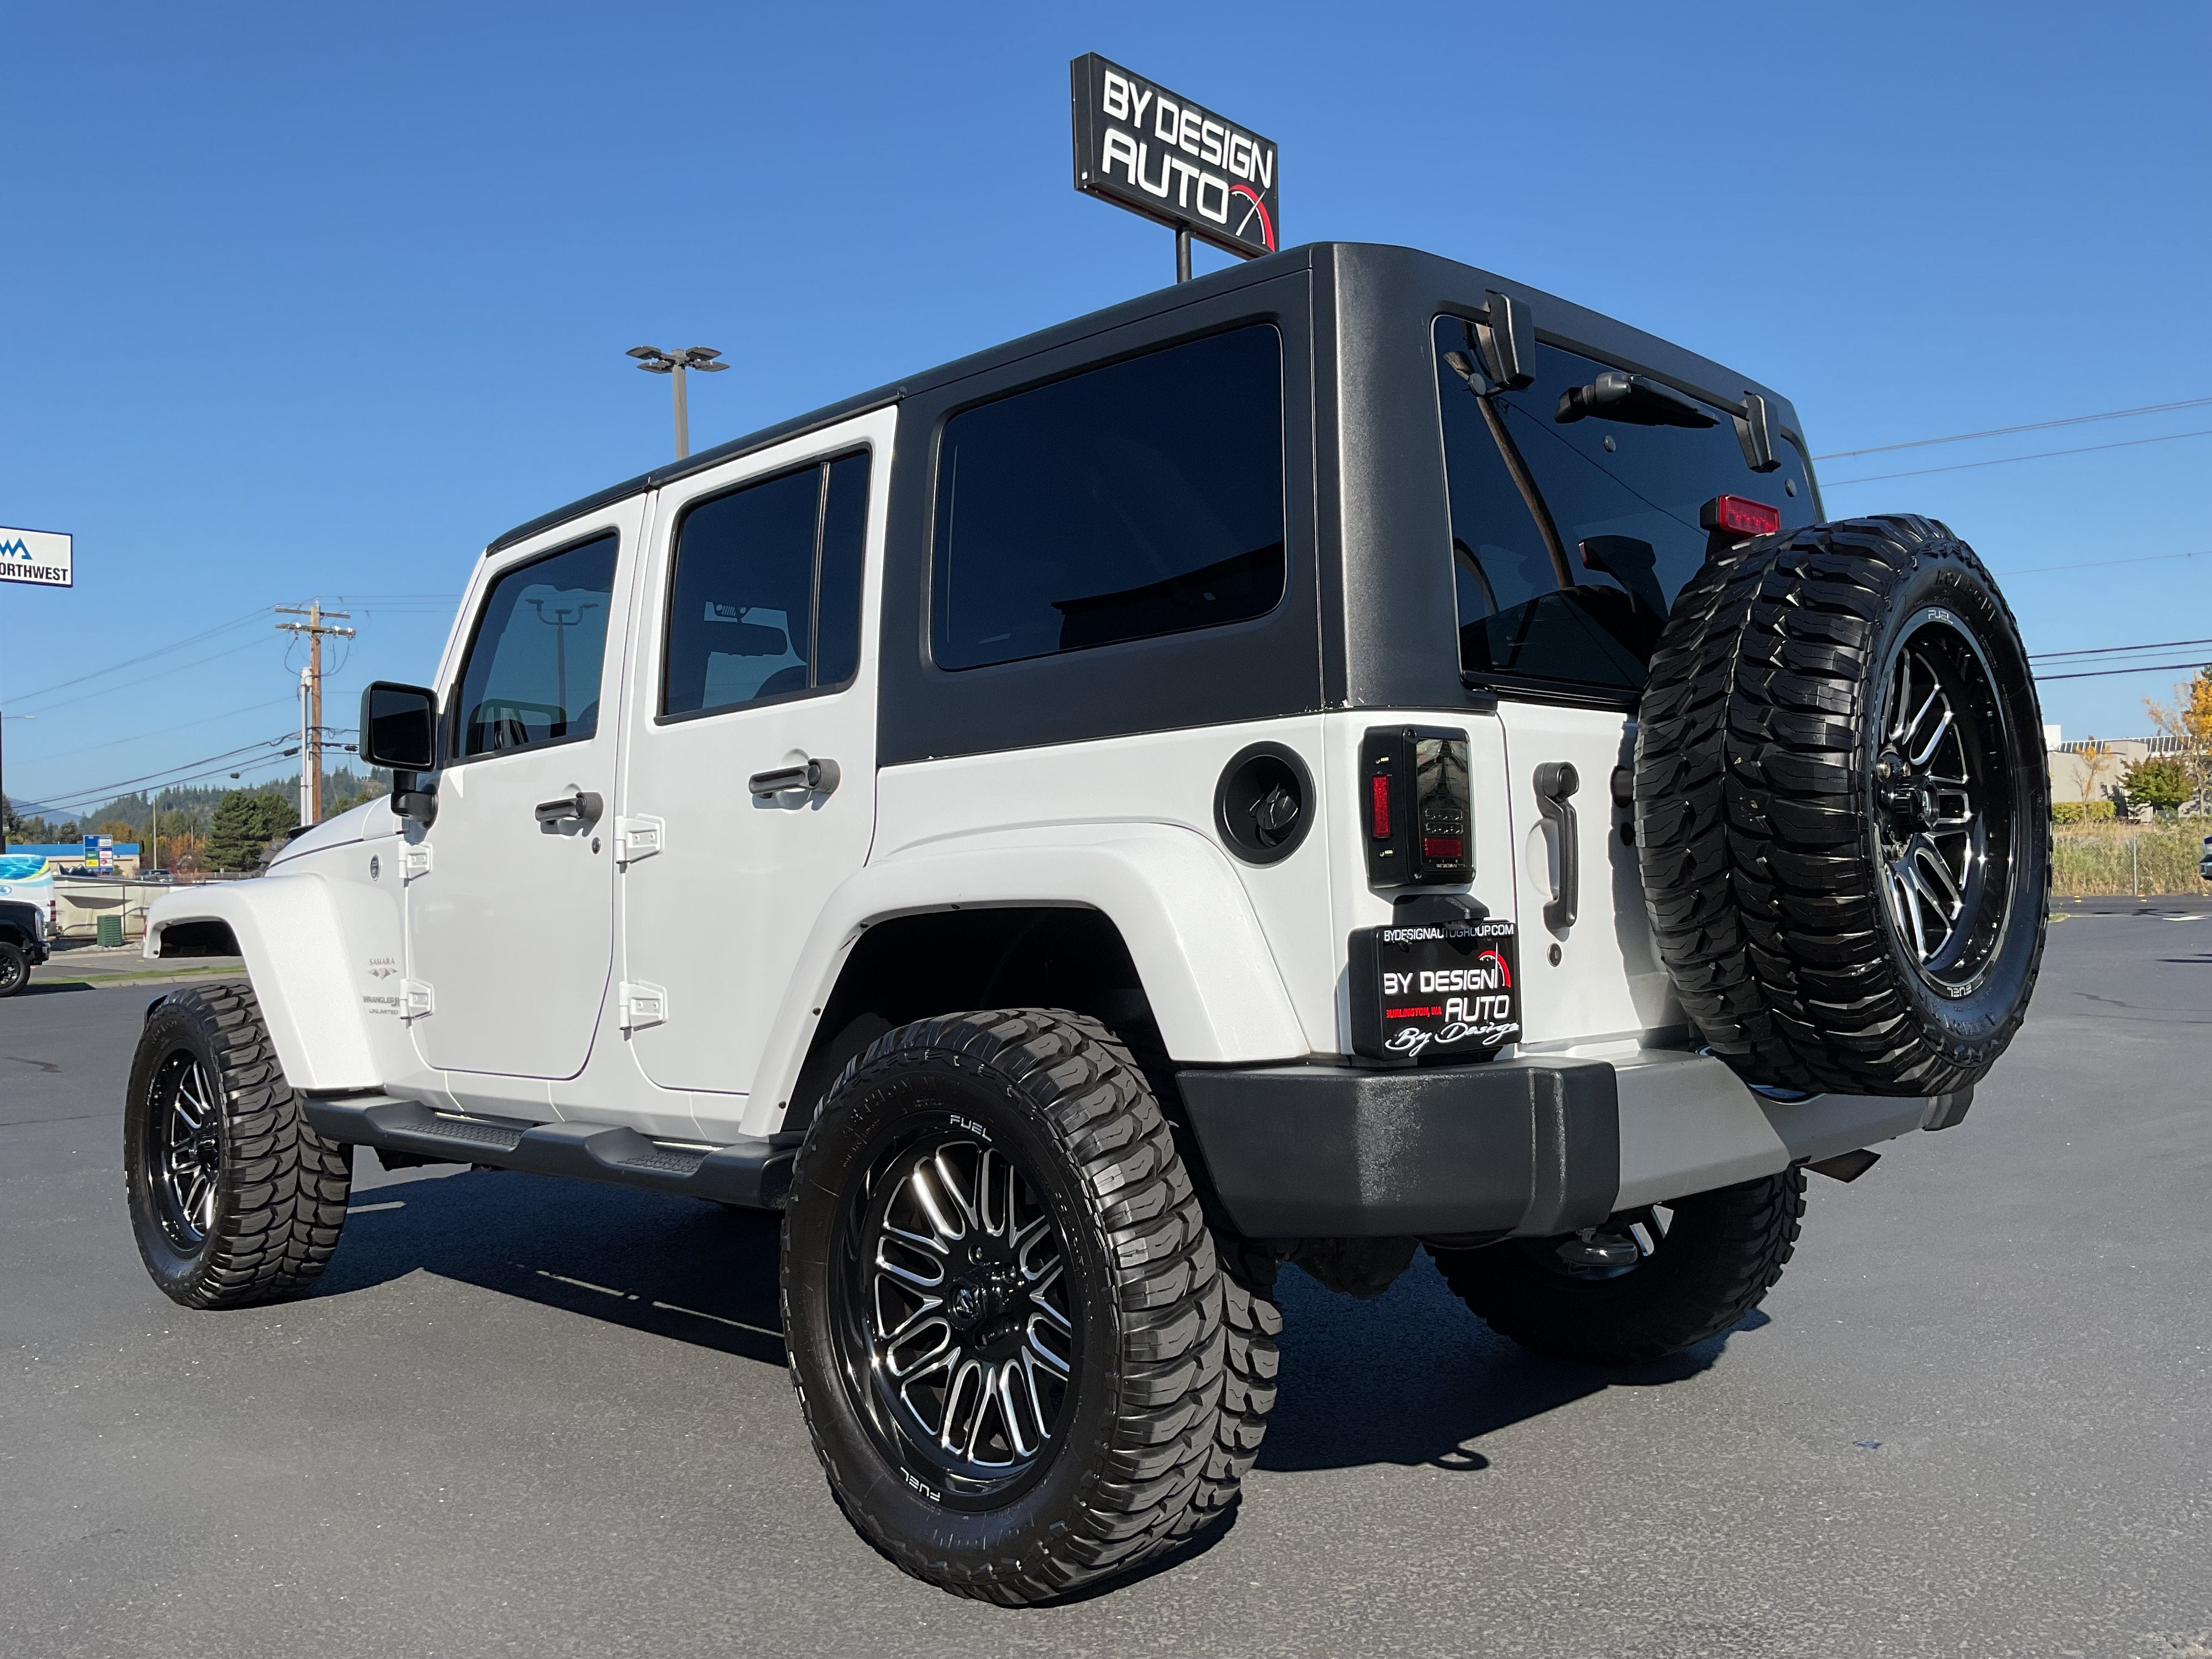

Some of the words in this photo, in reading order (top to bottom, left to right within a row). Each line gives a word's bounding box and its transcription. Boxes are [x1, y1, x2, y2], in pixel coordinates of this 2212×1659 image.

[1103, 70, 1152, 128] BY
[1155, 97, 1273, 189] DESIGN
[1102, 128, 1229, 224] AUTO
[1928, 610, 1953, 625] FUEL
[369, 957, 395, 966] SAHARA
[1384, 973, 1413, 995] BY
[1420, 969, 1498, 992] DESIGN
[1946, 983, 1972, 998] FUEL
[1431, 1006, 1442, 1015] WA
[1445, 995, 1509, 1022] AUTO
[1385, 1027, 1432, 1057] By
[1434, 1020, 1519, 1045] Design
[950, 1114, 992, 1142] FUEL
[900, 1466, 940, 1502] FUEL
